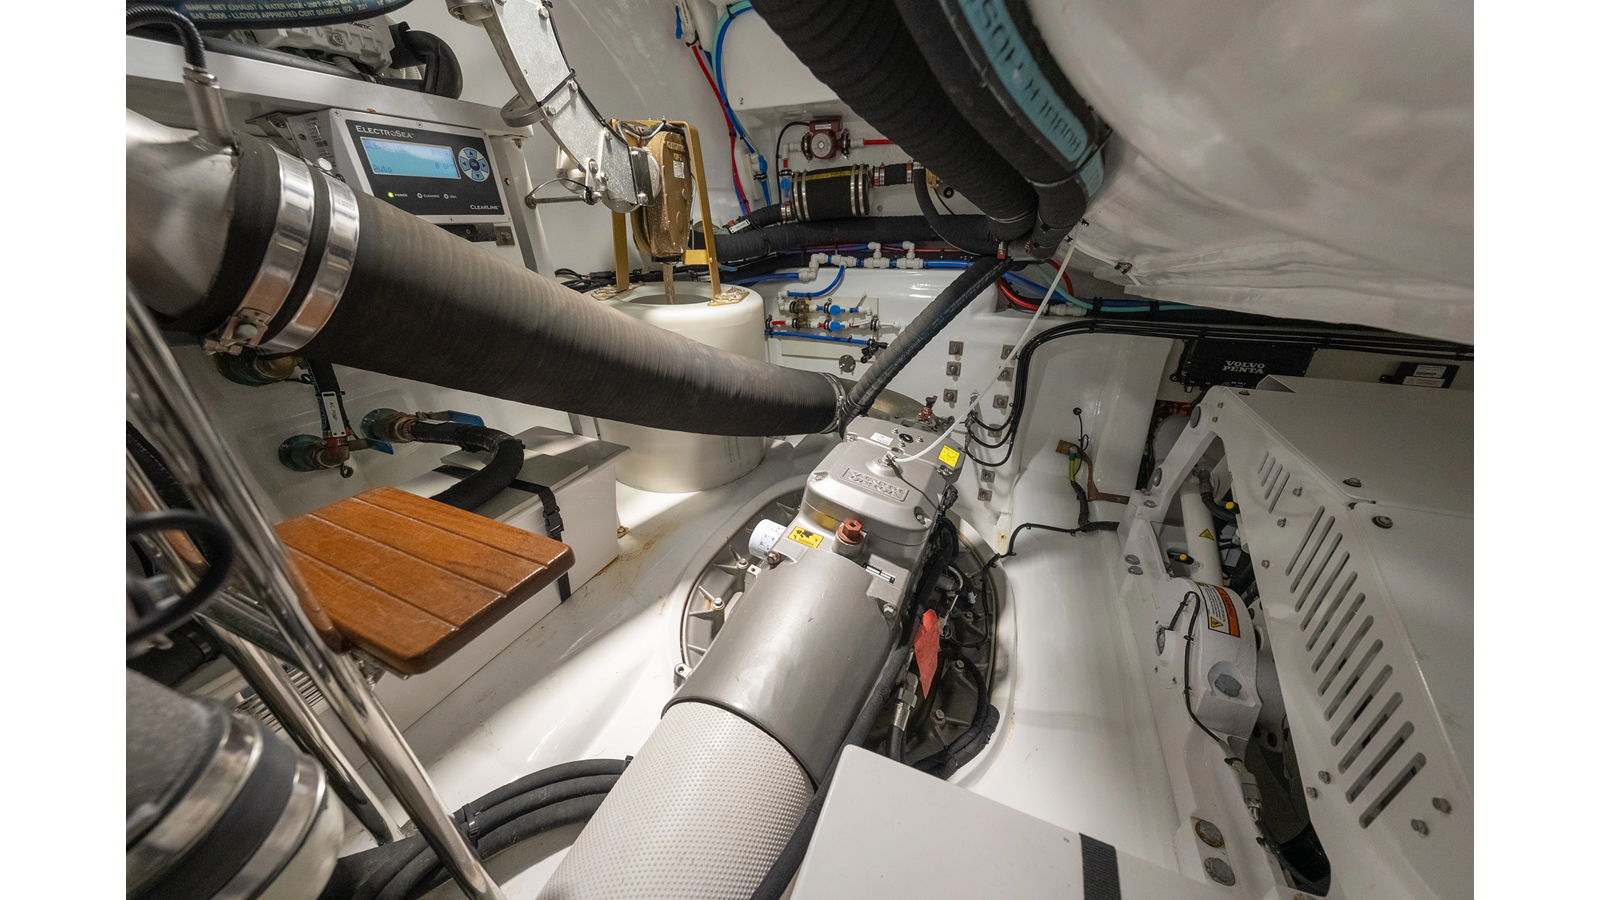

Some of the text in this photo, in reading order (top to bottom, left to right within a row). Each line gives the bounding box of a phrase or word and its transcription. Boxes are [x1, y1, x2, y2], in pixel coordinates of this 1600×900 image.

[231, 11, 261, 19] LLOYD'S
[260, 10, 298, 18] APPROVED
[298, 9, 316, 17] CERT
[355, 124, 413, 139] ELECTROSEA
[1226, 360, 1266, 369] VOLVO
[1222, 365, 1264, 374] PENTA
[329, 401, 336, 409] AC
